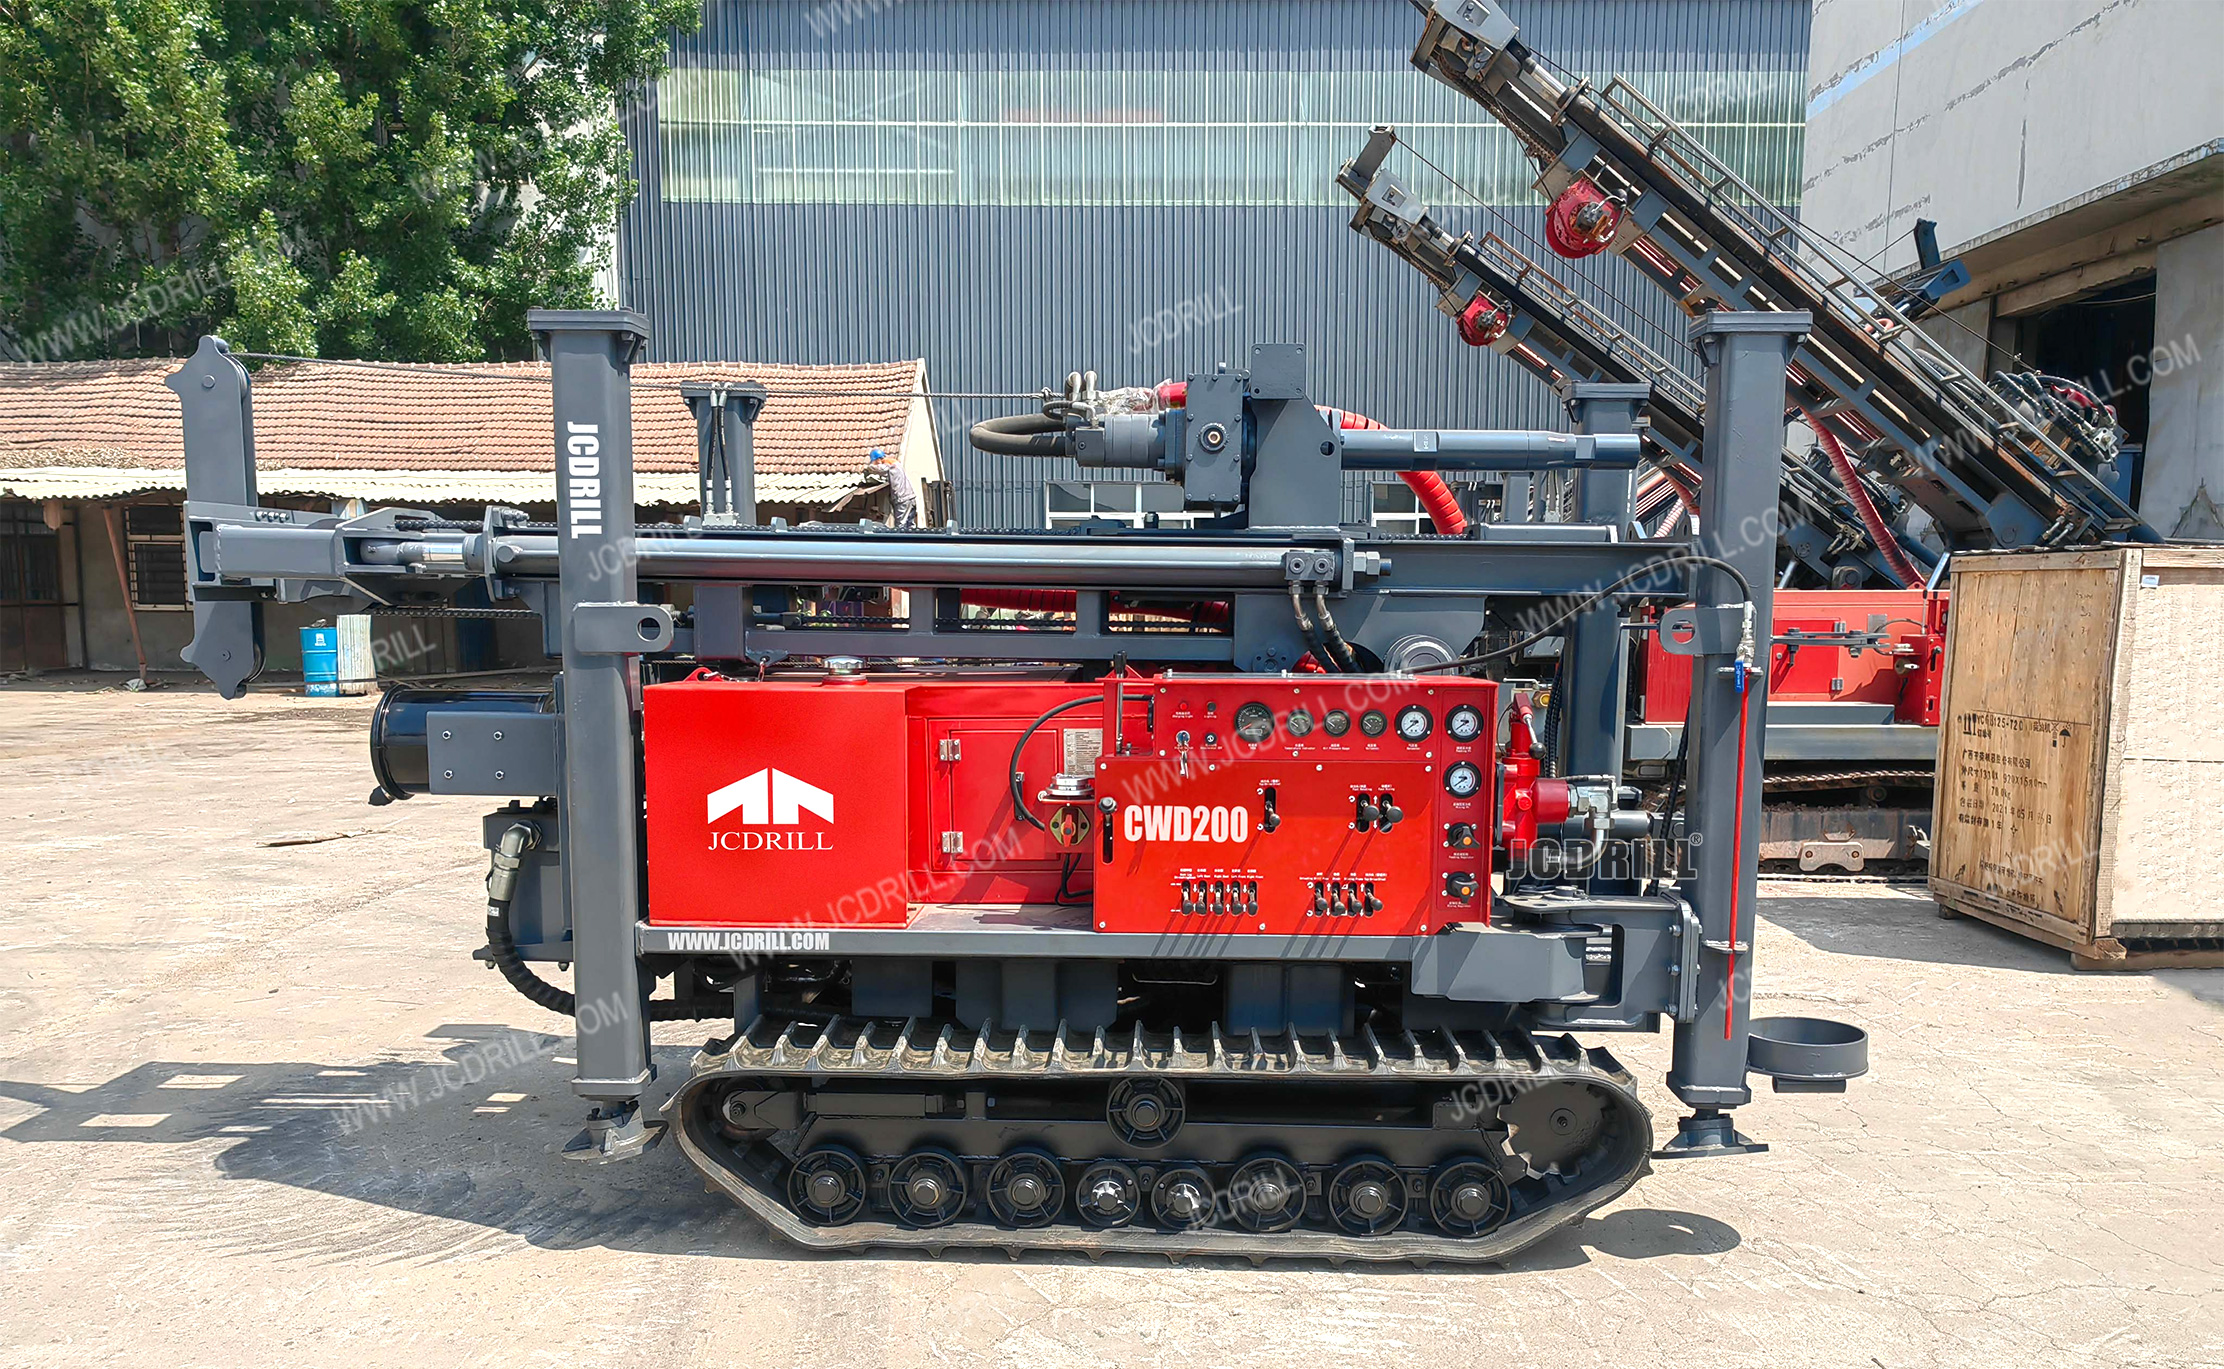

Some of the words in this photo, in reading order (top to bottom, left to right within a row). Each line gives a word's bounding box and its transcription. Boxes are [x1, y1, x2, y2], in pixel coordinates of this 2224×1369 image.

[566, 421, 603, 539] JCDRILL
[1124, 805, 1249, 843] CWD200
[707, 831, 834, 851] JCDRILL
[667, 932, 830, 951] WWW.JCDRILL.COM
